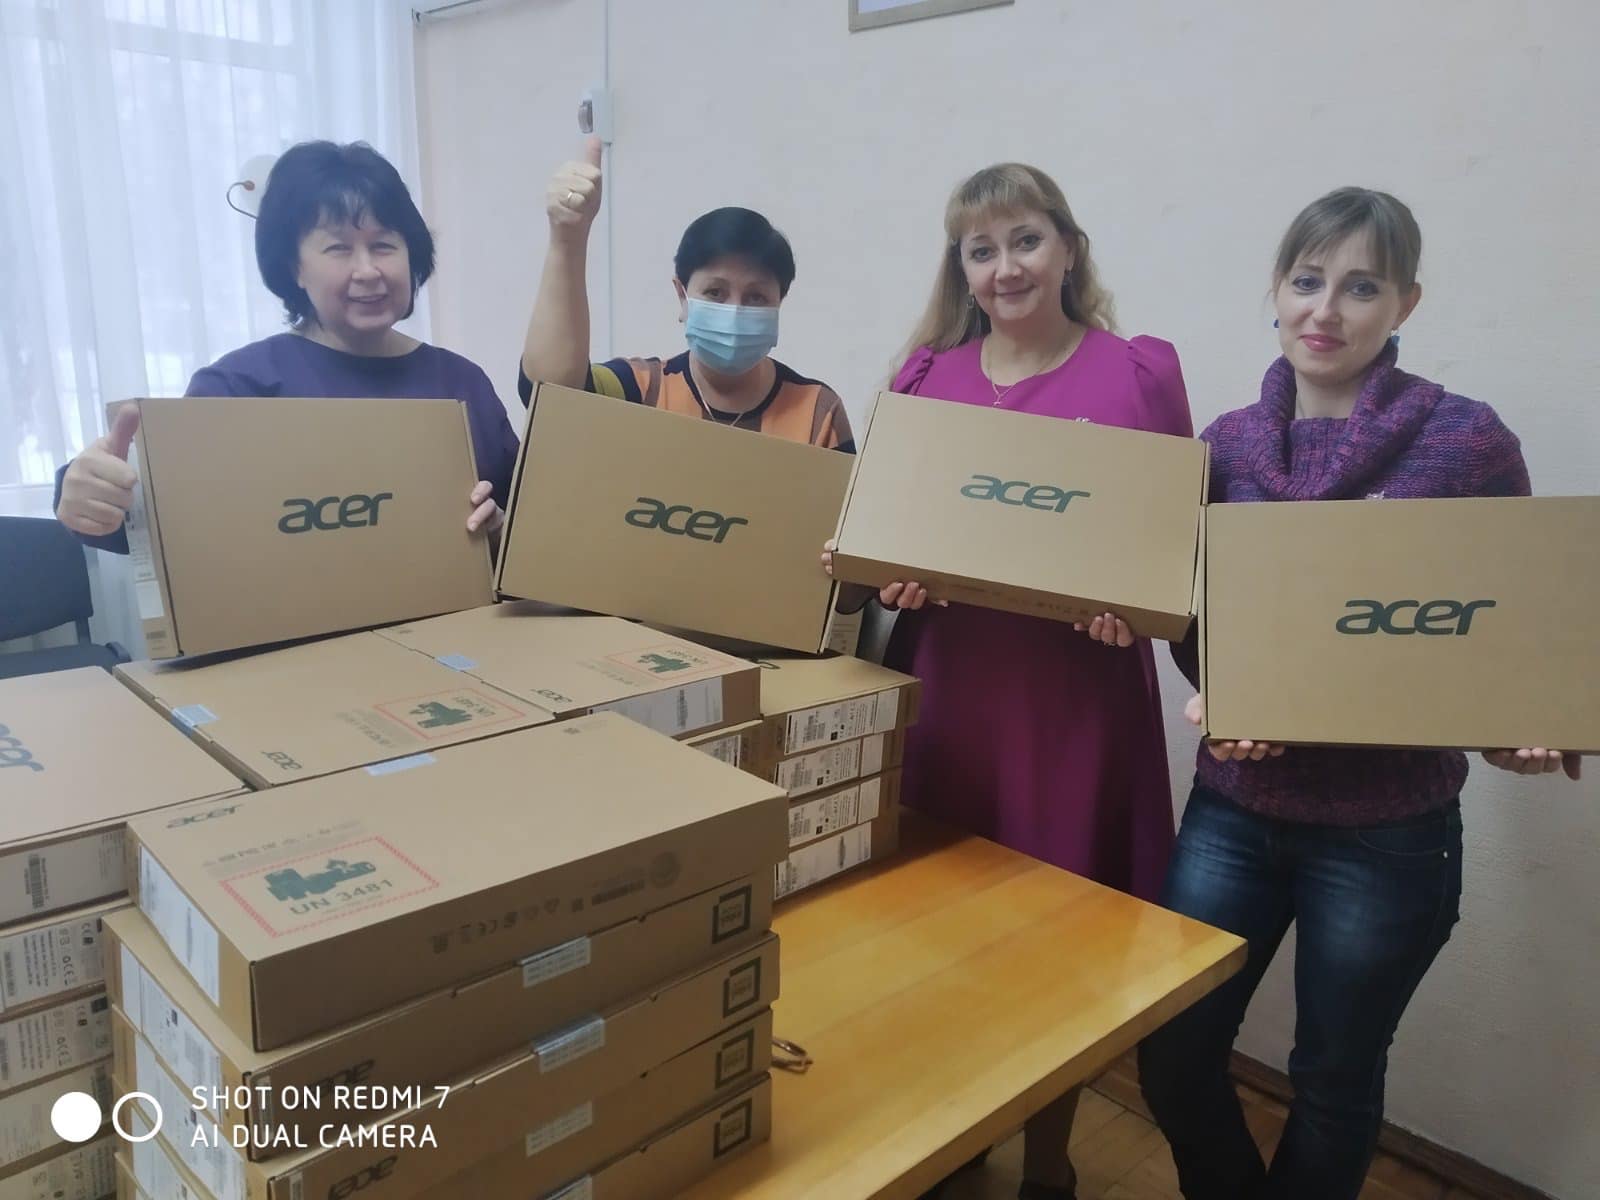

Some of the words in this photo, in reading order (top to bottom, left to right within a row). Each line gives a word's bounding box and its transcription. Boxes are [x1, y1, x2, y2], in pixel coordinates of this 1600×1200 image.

[278, 492, 393, 534] acer
[960, 474, 1091, 513] acer
[624, 497, 749, 544] acer
[1335, 599, 1497, 636] acer
[0, 723, 45, 772] cer
[166, 803, 245, 829] acer
[289, 897, 331, 914] UN
[335, 879, 393, 900] 3481
